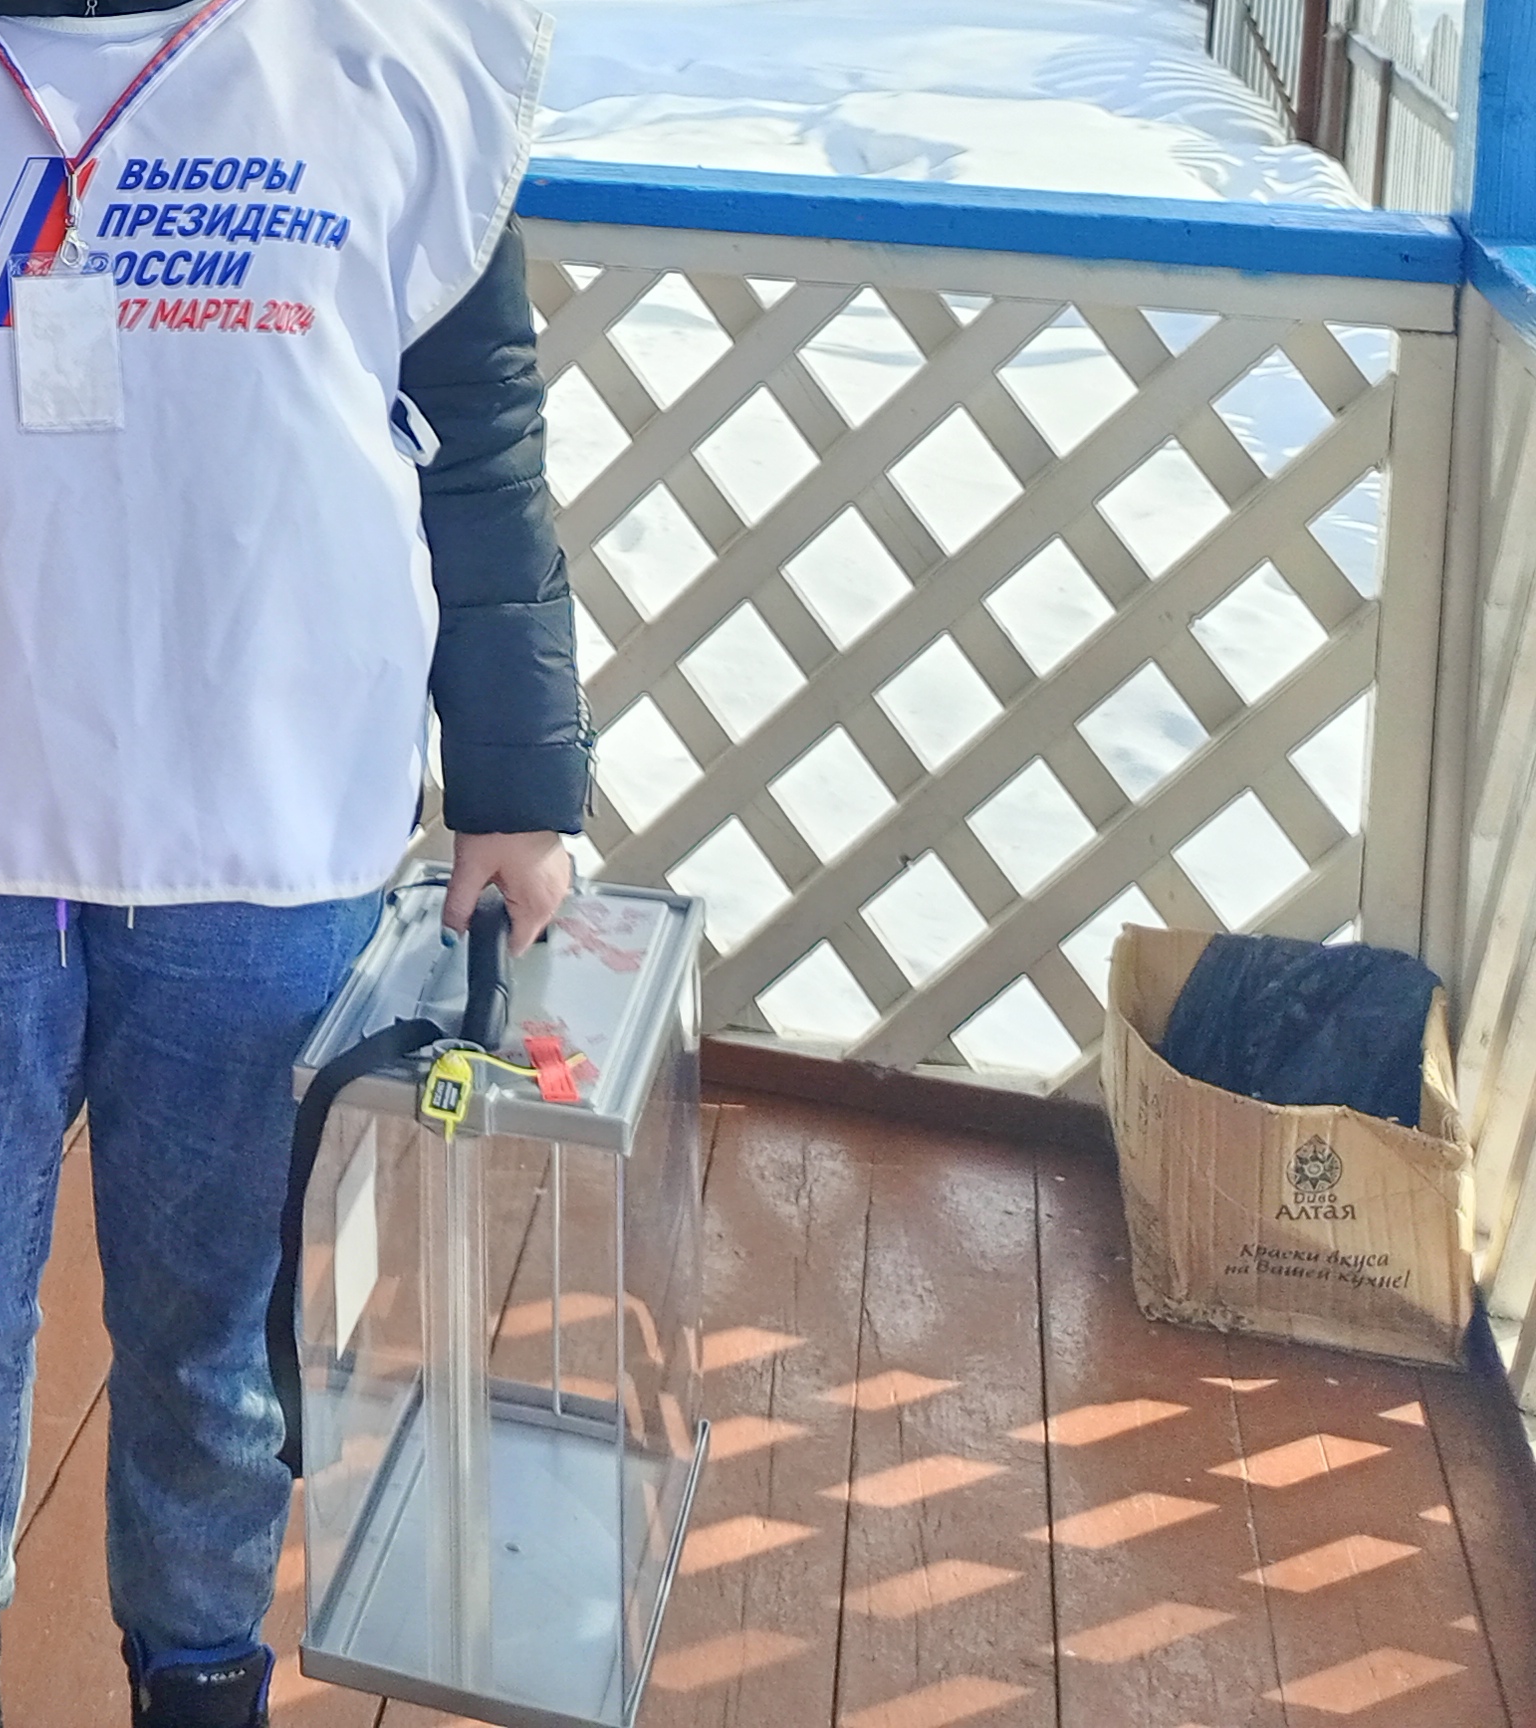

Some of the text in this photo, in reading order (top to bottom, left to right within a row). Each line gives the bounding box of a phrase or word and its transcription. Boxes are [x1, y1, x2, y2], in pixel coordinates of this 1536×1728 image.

[116, 157, 305, 194] ВЫБОРЫ
[96, 203, 351, 251] ПРЕЗИДЕНТА
[148, 298, 254, 331] МАРТА
[255, 299, 316, 334] 2024
[1239, 1243, 1390, 1273] Краски вкуса
[1224, 1263, 1250, 1276] на
[1337, 1269, 1412, 1291] кухне!
